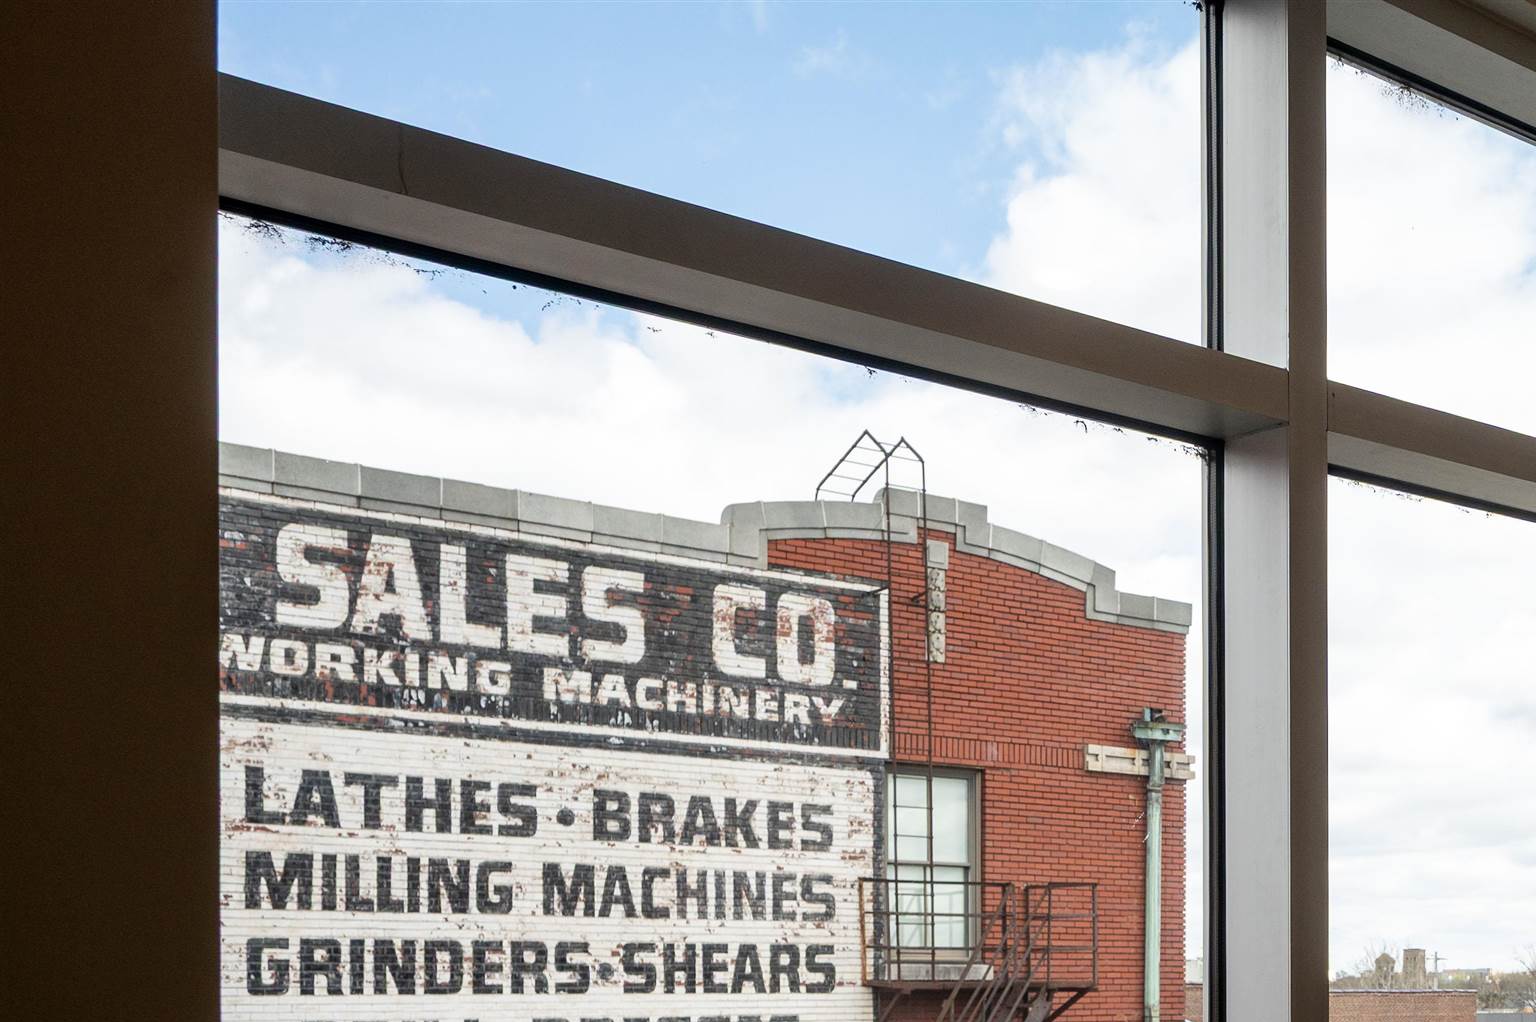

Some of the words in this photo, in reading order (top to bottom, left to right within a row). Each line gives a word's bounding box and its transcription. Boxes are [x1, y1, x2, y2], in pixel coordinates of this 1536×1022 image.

[276, 523, 646, 664] SALES
[219, 633, 511, 697] WORKING
[544, 667, 846, 724] MACHINERY
[244, 766, 537, 837] LATHES
[593, 788, 834, 851] BRAKES
[244, 850, 513, 913] MILLING
[542, 862, 836, 921] MACHINES
[246, 937, 590, 995] GRINDERS
[622, 943, 836, 993] SHEARS
